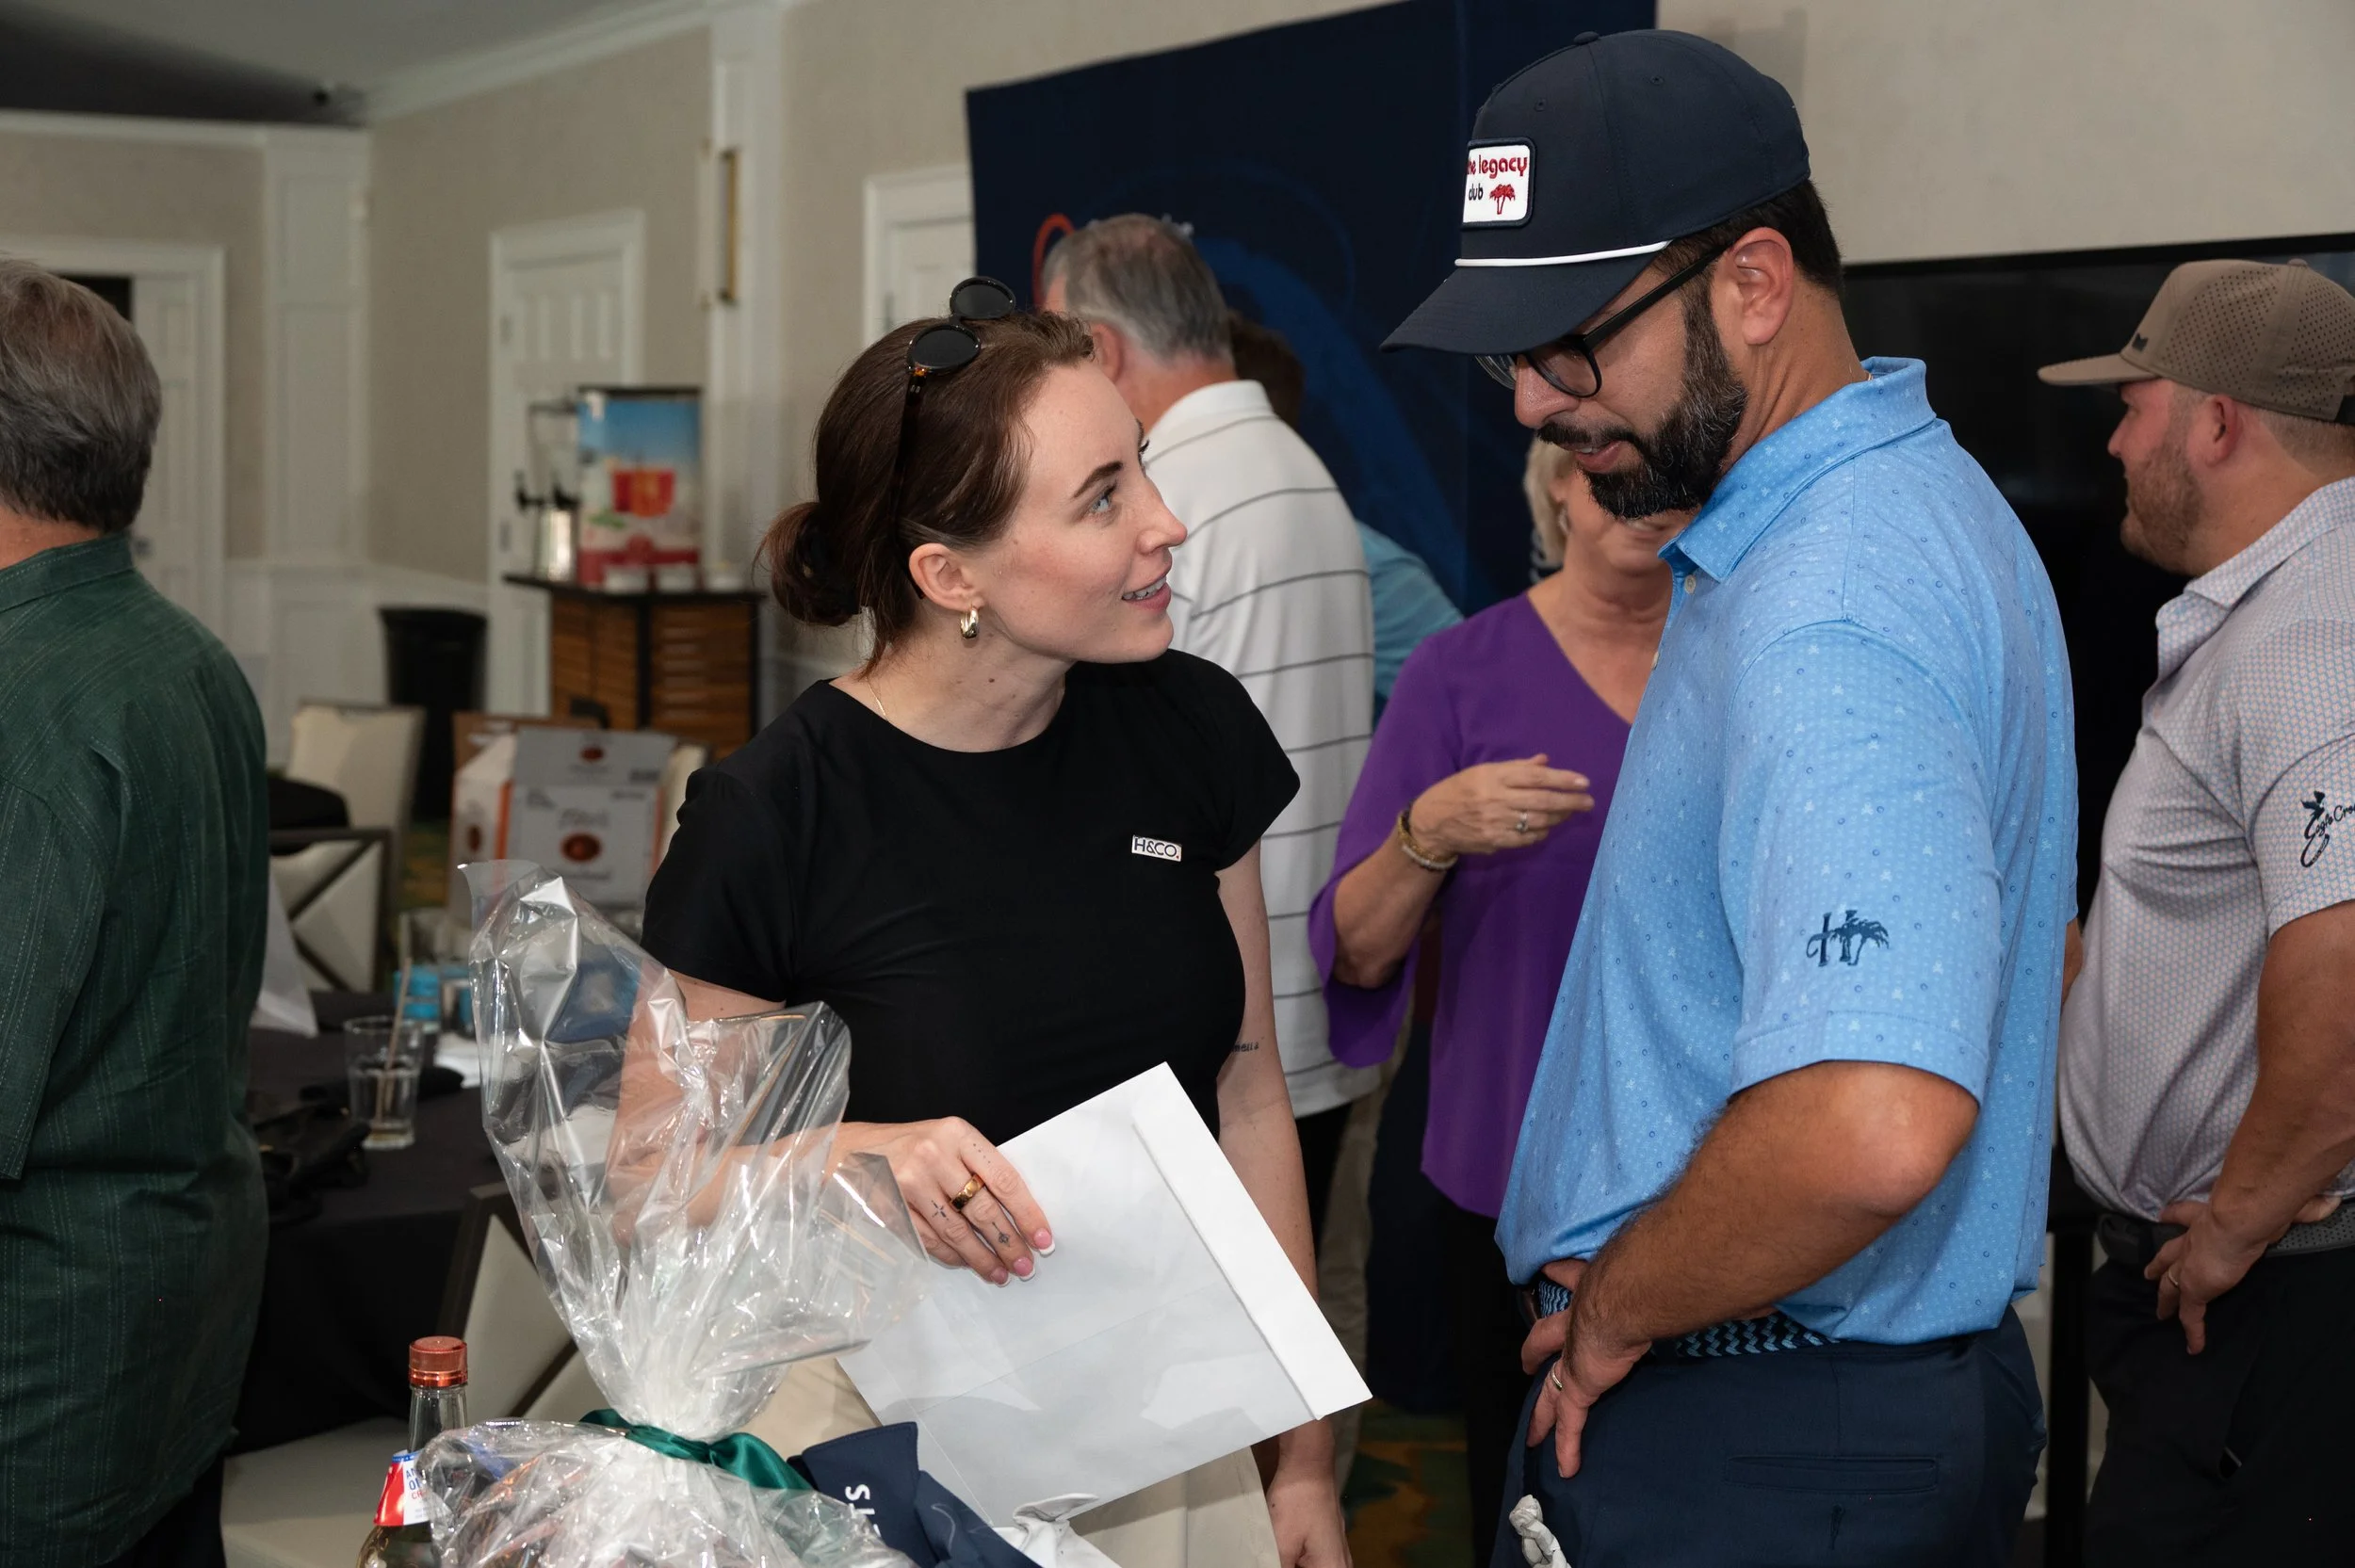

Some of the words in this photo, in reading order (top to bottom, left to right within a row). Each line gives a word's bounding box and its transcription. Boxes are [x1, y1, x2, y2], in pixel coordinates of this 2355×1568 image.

[1479, 154, 1528, 179] legacy
[1469, 183, 1484, 201] club
[1133, 837, 1179, 859] H&CO.
